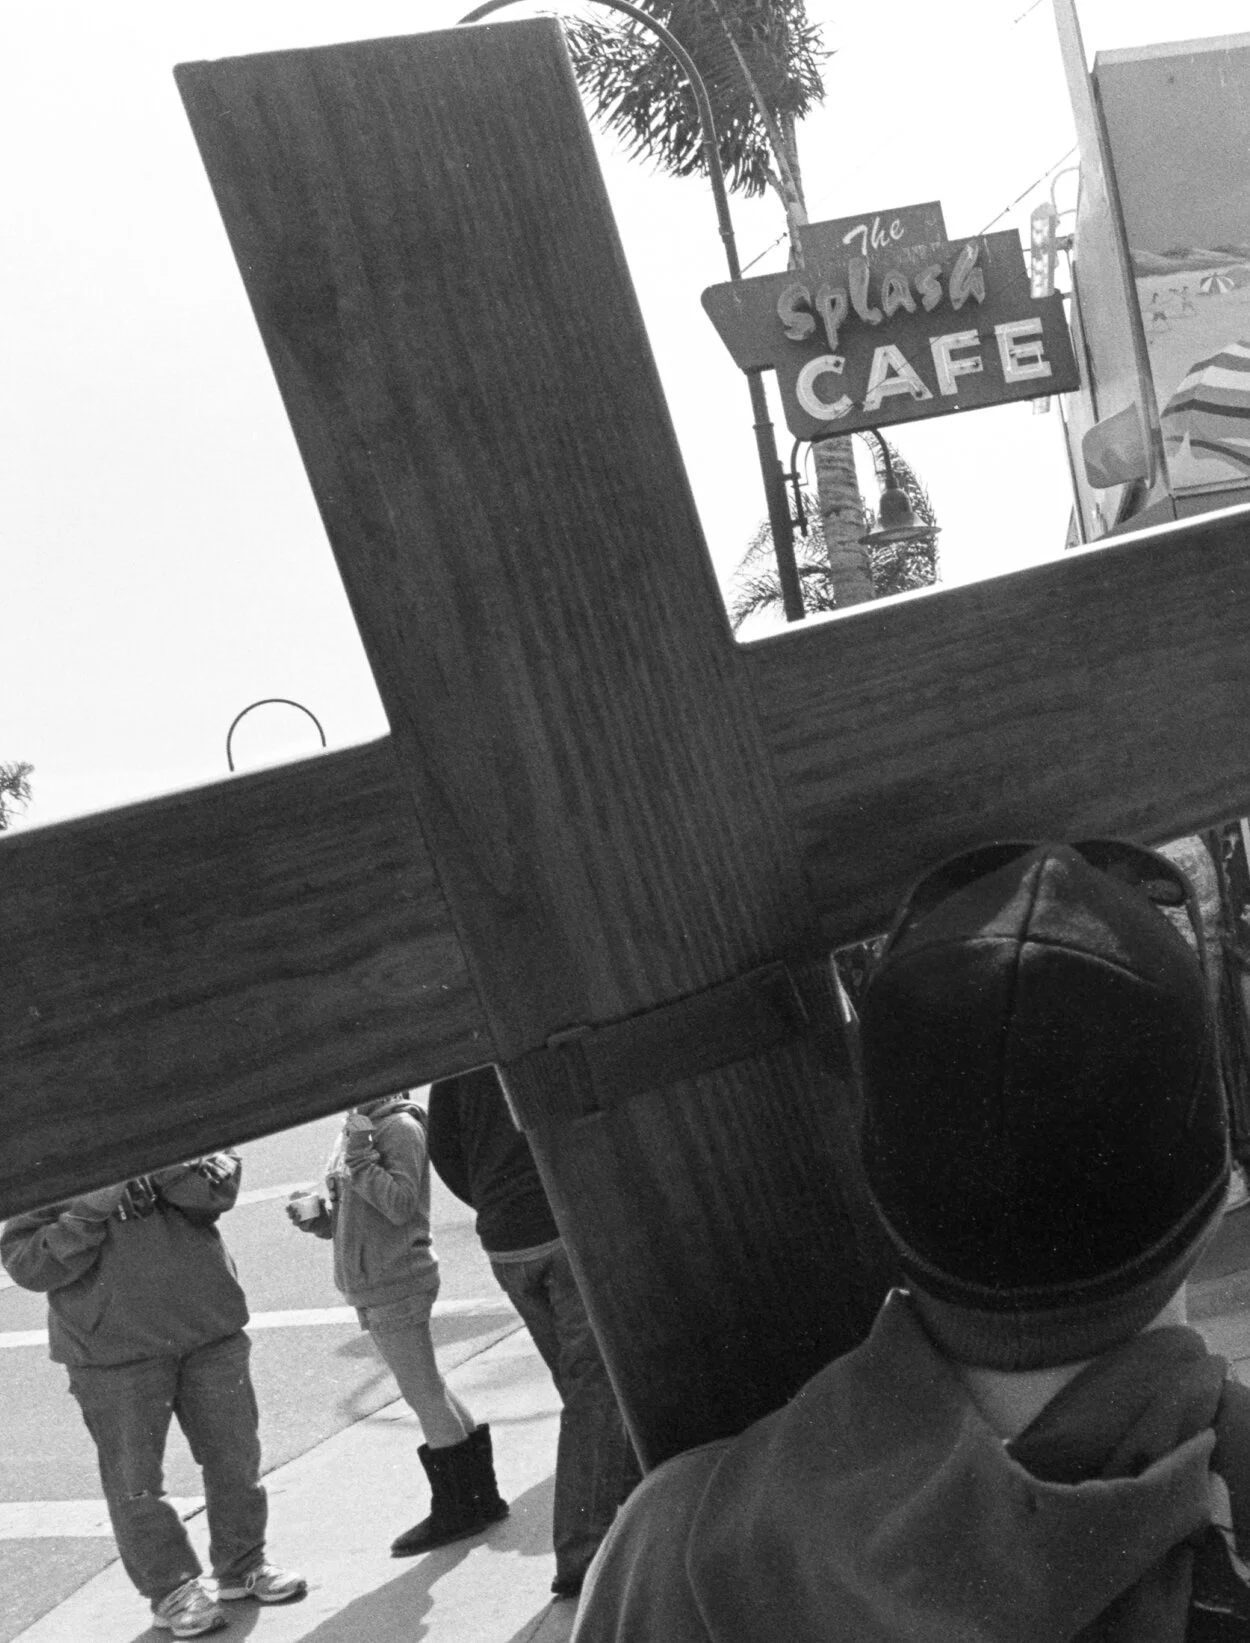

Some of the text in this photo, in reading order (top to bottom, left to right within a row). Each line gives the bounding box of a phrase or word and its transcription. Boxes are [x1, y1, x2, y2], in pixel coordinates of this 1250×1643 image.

[843, 216, 905, 255] The
[777, 242, 986, 351] Splash
[795, 317, 1053, 421] CAFE
